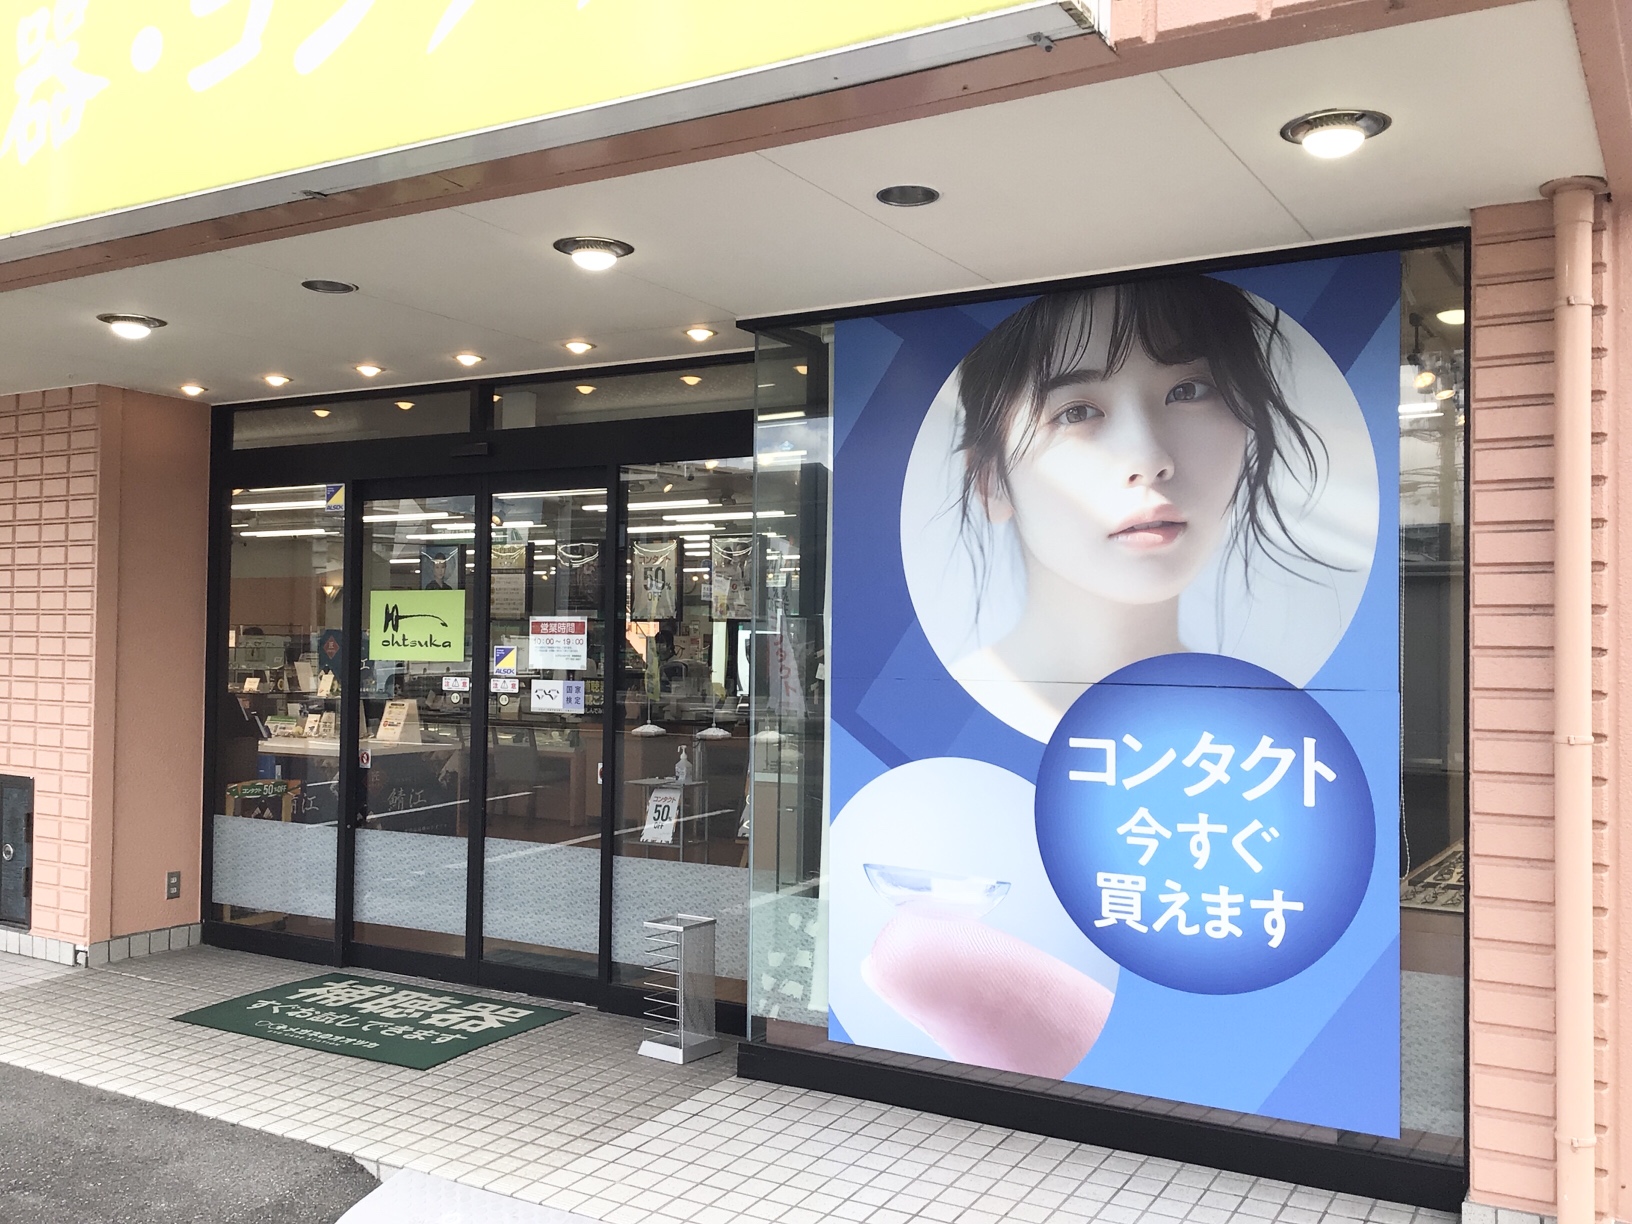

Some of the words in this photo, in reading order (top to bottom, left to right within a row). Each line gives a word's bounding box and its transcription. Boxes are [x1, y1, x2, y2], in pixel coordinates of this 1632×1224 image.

[381, 633, 452, 649] ohtsuka
[540, 622, 575, 634] 営業時間
[1068, 730, 1338, 808] コンタクト
[387, 787, 427, 812] 鯖江
[652, 804, 672, 822] 50%
[1116, 806, 1280, 874] 今すぐ
[1093, 871, 1305, 949] 買えます
[245, 999, 469, 1046] すぐお試しできます
[285, 979, 535, 1034] 補聴器
